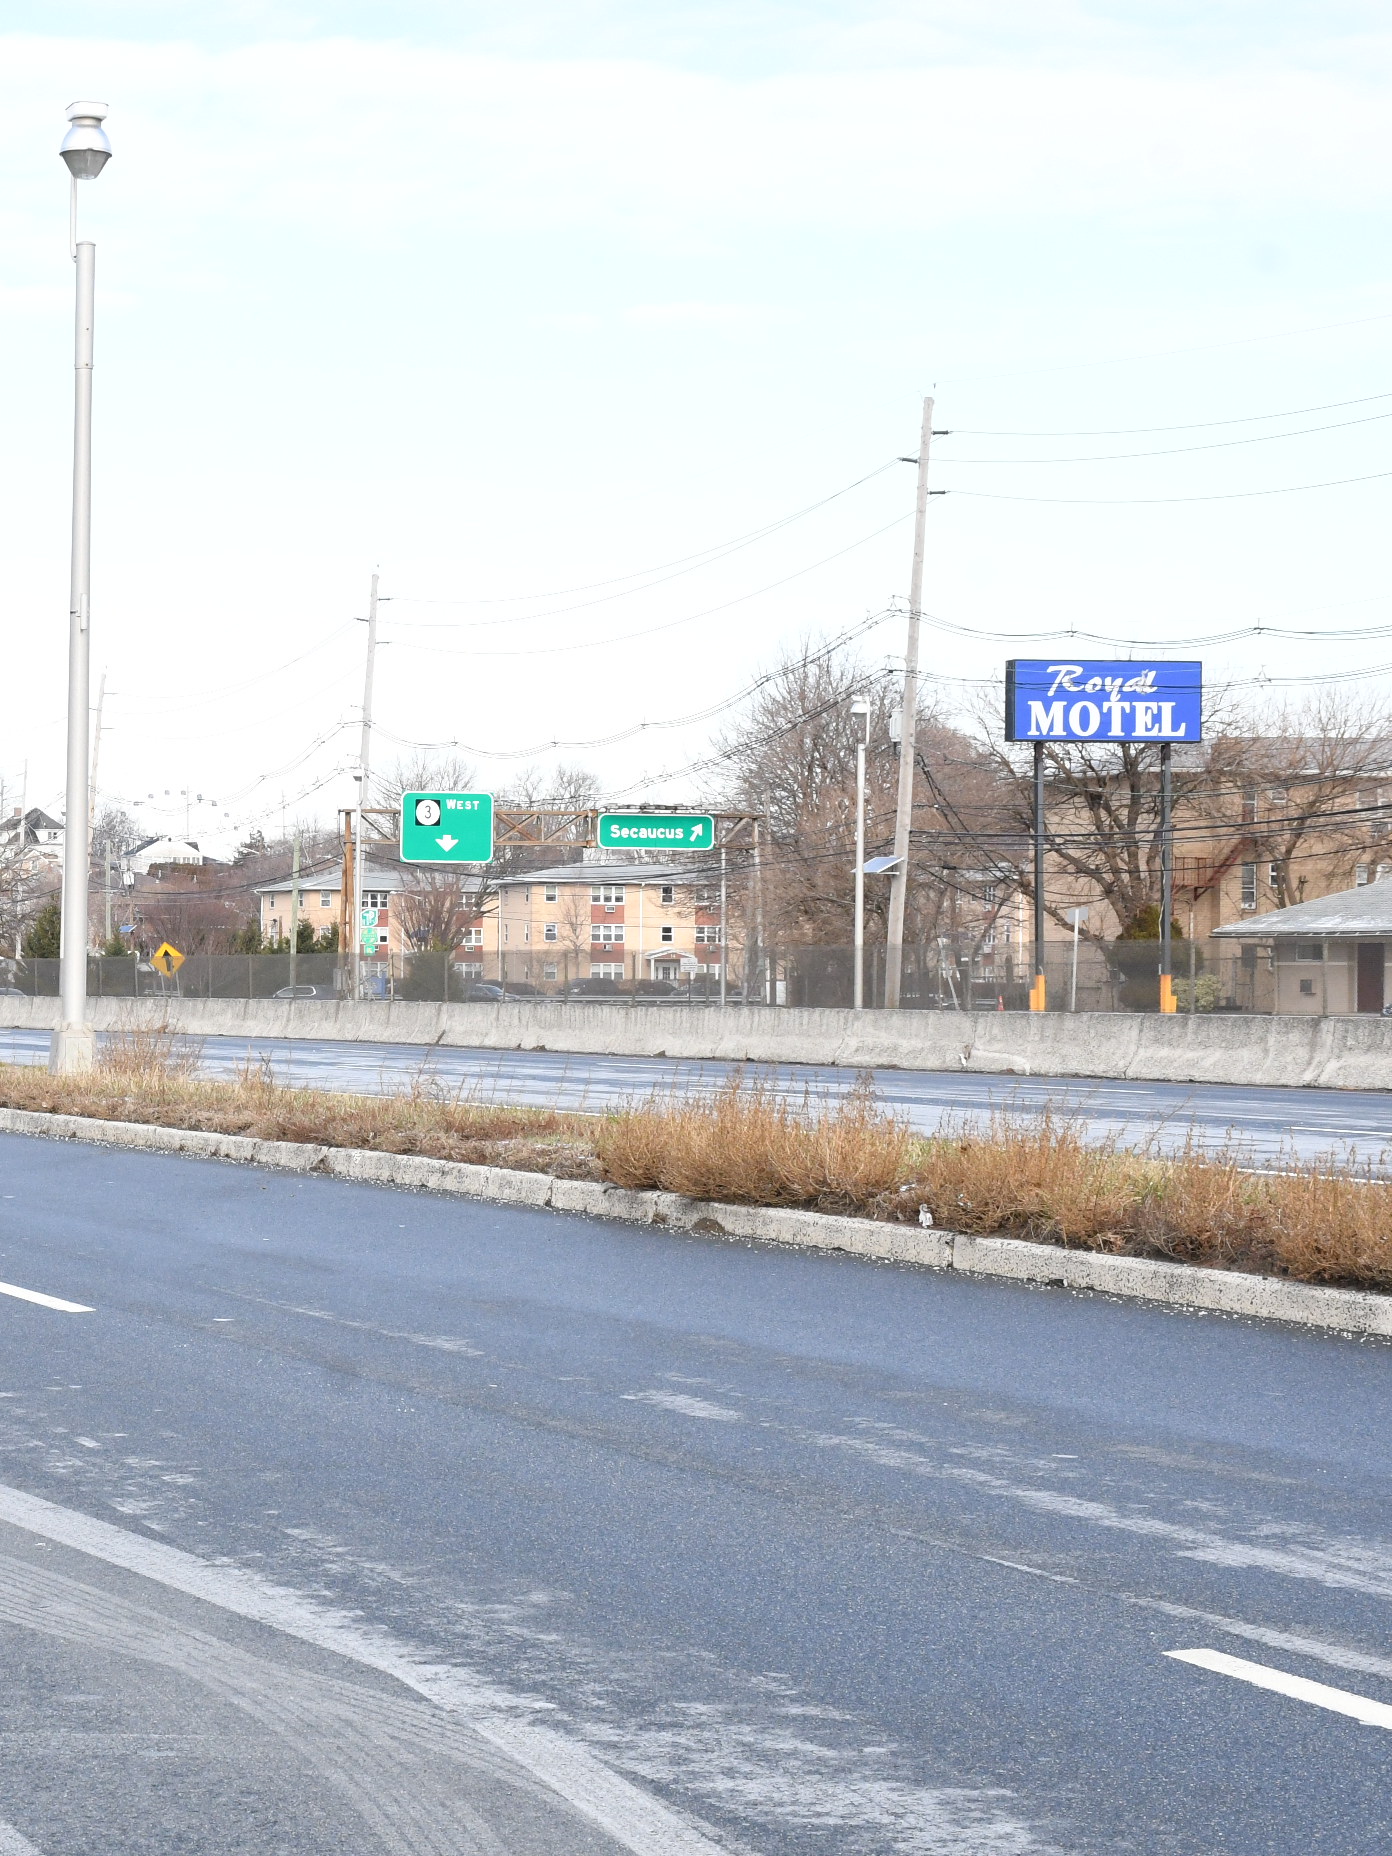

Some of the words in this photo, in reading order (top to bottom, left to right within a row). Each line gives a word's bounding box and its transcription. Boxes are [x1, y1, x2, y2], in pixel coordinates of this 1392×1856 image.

[1046, 664, 1159, 702] Royal
[1026, 700, 1187, 738] MOTEL
[424, 804, 433, 820] 3
[445, 798, 480, 811] WEST
[609, 823, 684, 840] Secaucus
